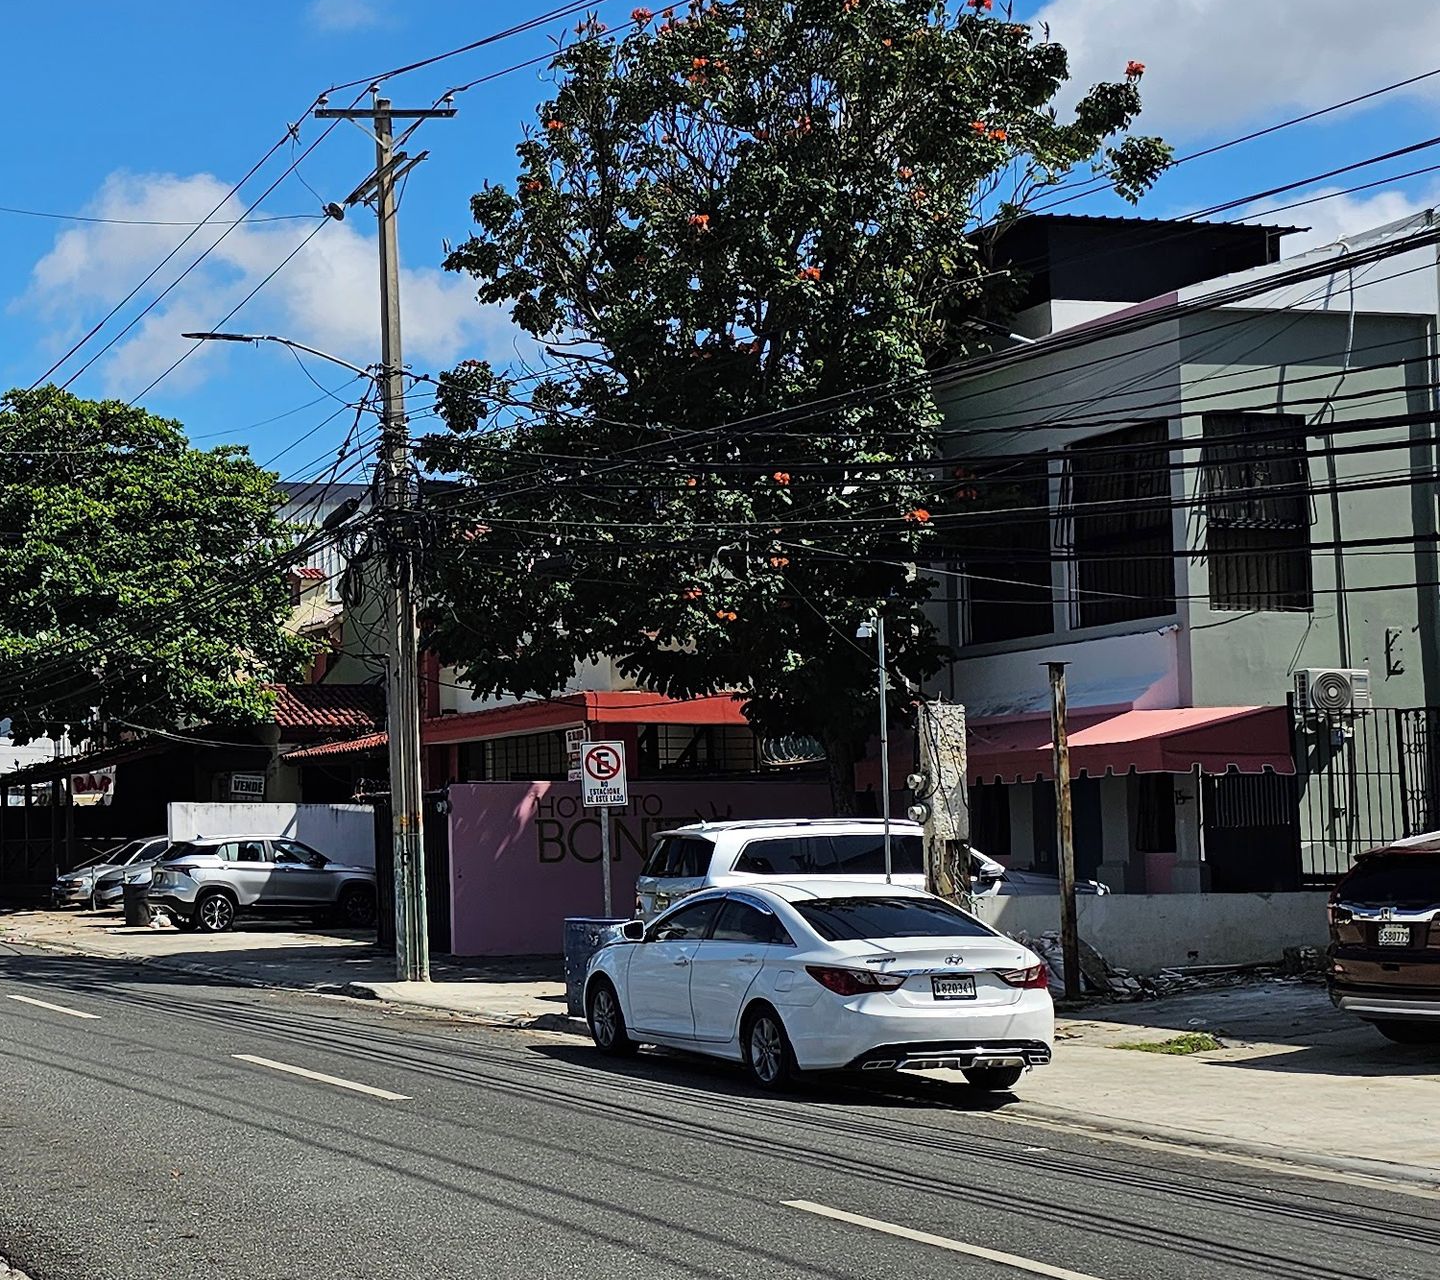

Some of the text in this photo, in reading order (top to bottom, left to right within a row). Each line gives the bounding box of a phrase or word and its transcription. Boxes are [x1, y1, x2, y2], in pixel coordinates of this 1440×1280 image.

[73, 774, 112, 793] BAR
[233, 779, 263, 793] VENDE
[589, 788, 621, 796] ESTACIONE
[587, 795, 595, 803] DE
[610, 794, 624, 802] LADO
